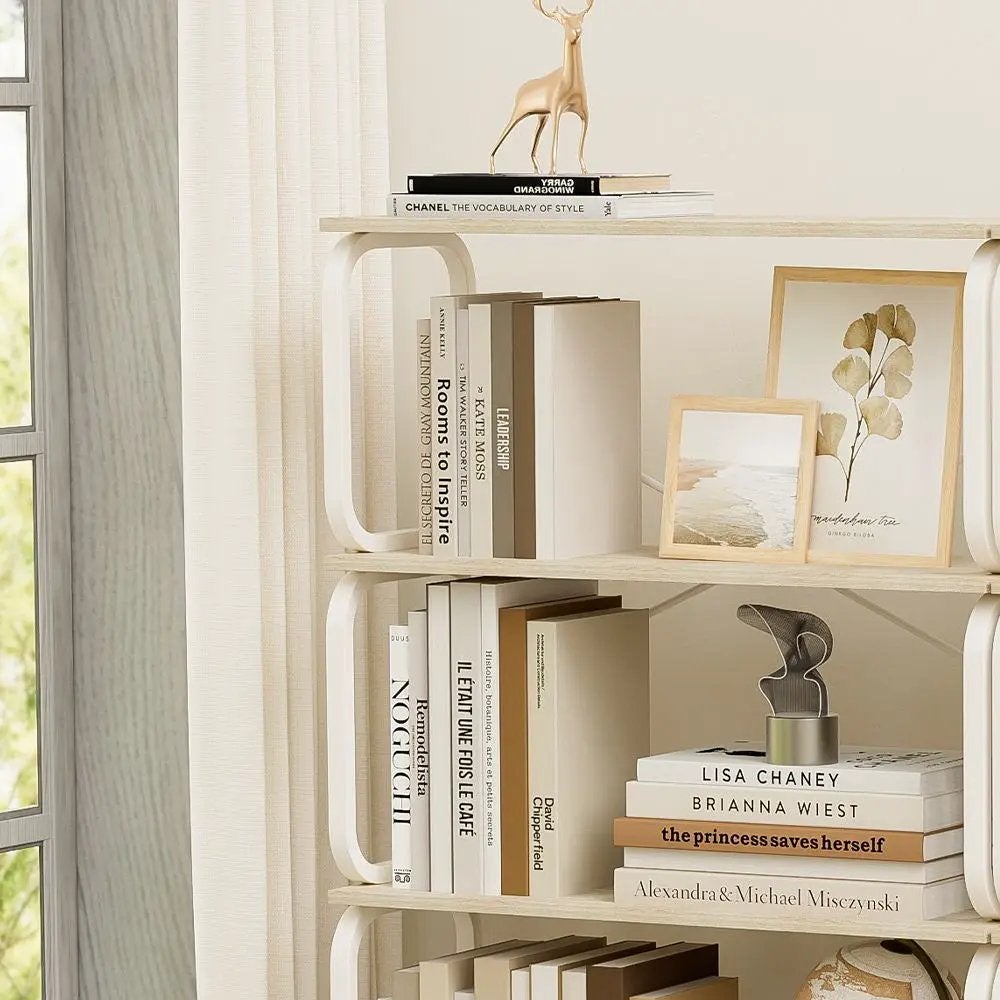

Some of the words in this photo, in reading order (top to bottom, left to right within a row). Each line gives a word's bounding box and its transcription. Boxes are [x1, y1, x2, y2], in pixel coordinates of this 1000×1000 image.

[405, 203, 449, 212] CHANEL
[452, 204, 471, 212] THE
[473, 204, 536, 213] VOCABULARY
[539, 204, 553, 212] OF
[555, 205, 584, 213] STYLE
[604, 201, 612, 217] Yale
[420, 334, 431, 408] MOUNTAIN
[437, 378, 451, 445] Rooms
[475, 398, 484, 437] KATE
[421, 413, 431, 445] GRAY
[496, 408, 509, 470] LEADERSHIP
[421, 451, 432, 469] DE
[438, 451, 451, 471] to
[476, 441, 485, 481] MOSS
[421, 473, 432, 529] SECRETO
[435, 479, 451, 544] Inspire
[422, 532, 433, 545] EL
[484, 694, 493, 744] botanique,
[391, 679, 411, 825] NOGUCHI
[416, 699, 430, 797] Remodelista
[487, 769, 492, 780] et
[703, 767, 745, 783] LISA
[757, 769, 840, 787] CHANEY
[485, 782, 493, 809] petits
[693, 797, 786, 815] BRIANNA
[797, 802, 858, 818] WIEST
[544, 798, 554, 831] David
[533, 797, 543, 870] Chipperfield
[661, 827, 690, 842] the
[693, 829, 768, 847] princess
[770, 835, 819, 850] saves
[821, 835, 885, 853] herself
